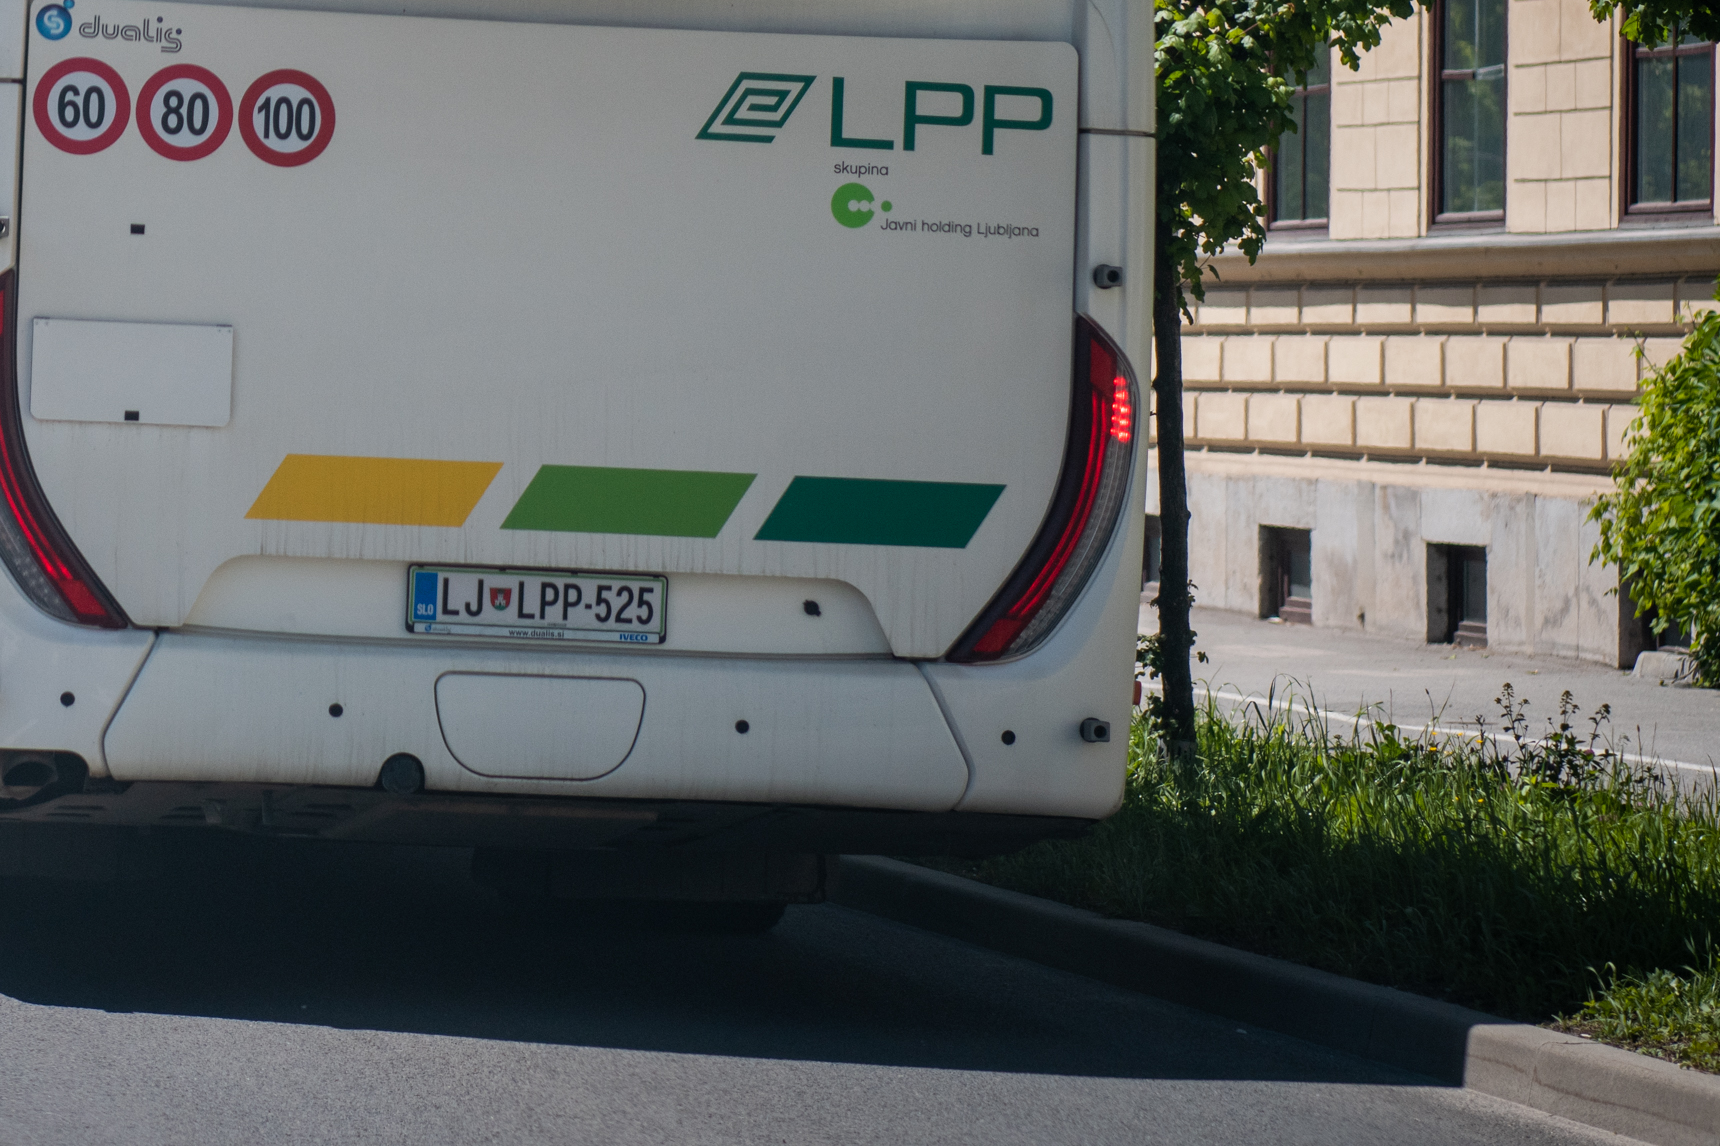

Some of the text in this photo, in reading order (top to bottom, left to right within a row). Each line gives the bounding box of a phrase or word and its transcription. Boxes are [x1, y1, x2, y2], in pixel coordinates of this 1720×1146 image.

[78, 14, 182, 53] dualis
[57, 83, 106, 129] 60
[160, 89, 210, 136] 80
[256, 95, 316, 142] 100
[830, 76, 1054, 155] LPP
[833, 160, 889, 178] skupina
[880, 218, 1040, 239] Javni holding Ljubljana
[416, 603, 434, 616] SLO
[441, 577, 654, 625] LJ LPP-525
[508, 628, 565, 639] www.dualis.si
[618, 633, 648, 642] IVECO
